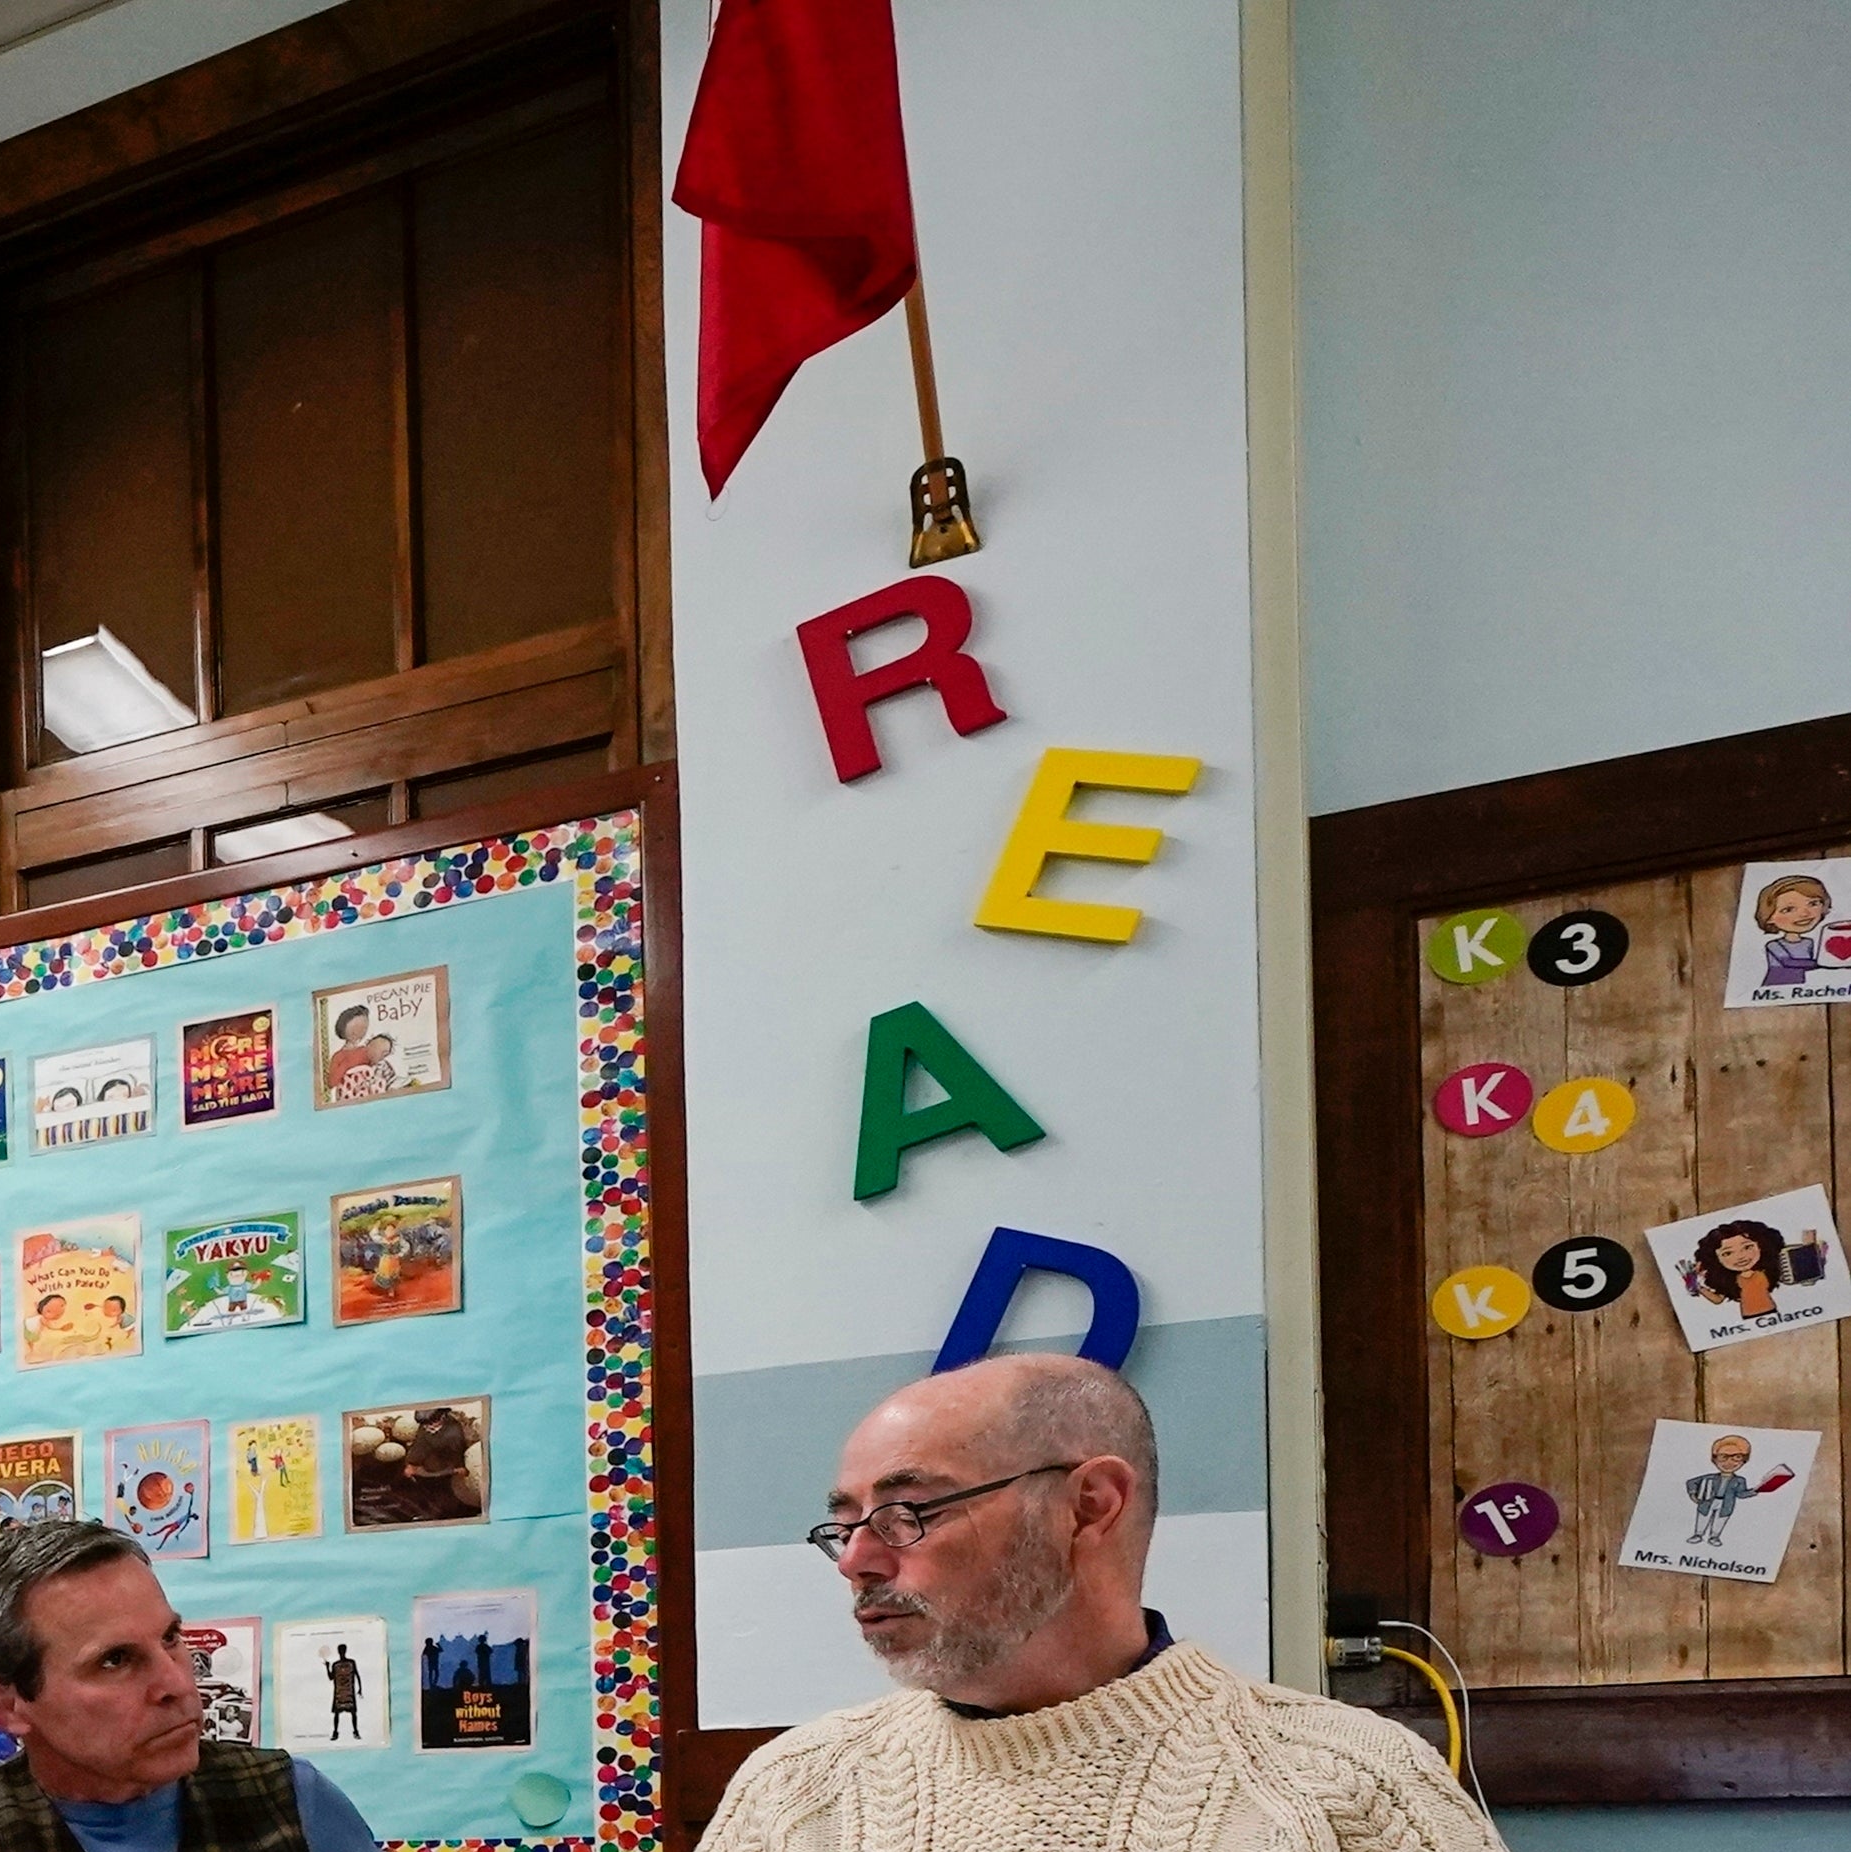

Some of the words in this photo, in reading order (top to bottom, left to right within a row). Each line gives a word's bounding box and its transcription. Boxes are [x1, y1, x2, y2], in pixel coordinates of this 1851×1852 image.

[1453, 917, 1506, 974] K
[1554, 922, 1601, 976] 3
[796, 575, 1203, 1375] READ
[367, 986, 409, 1003] PECAN
[413, 983, 431, 993] PIE
[1751, 988, 1785, 1001] Ms.
[377, 998, 422, 1021] Baby
[190, 1034, 267, 1064] MORE
[191, 1053, 267, 1083] MORE
[192, 1073, 267, 1102] MORE
[1461, 1071, 1511, 1125] K
[1562, 1090, 1610, 1140] 4
[195, 1237, 269, 1263] YAKYU
[27, 1271, 55, 1286] What
[57, 1268, 75, 1277] Can
[79, 1267, 95, 1277] You
[98, 1268, 110, 1277] Do
[38, 1281, 63, 1293] With
[1560, 1248, 1608, 1300] 5
[1709, 1322, 1750, 1340] Mrs.
[1755, 1302, 1823, 1329] Calarco
[1474, 1494, 1531, 1546] 1st
[1634, 1548, 1672, 1567] Mrs.
[1676, 1554, 1767, 1577] Nicholson
[455, 1704, 501, 1719] without
[463, 1691, 493, 1705] Boys
[459, 1719, 498, 1733] Names
